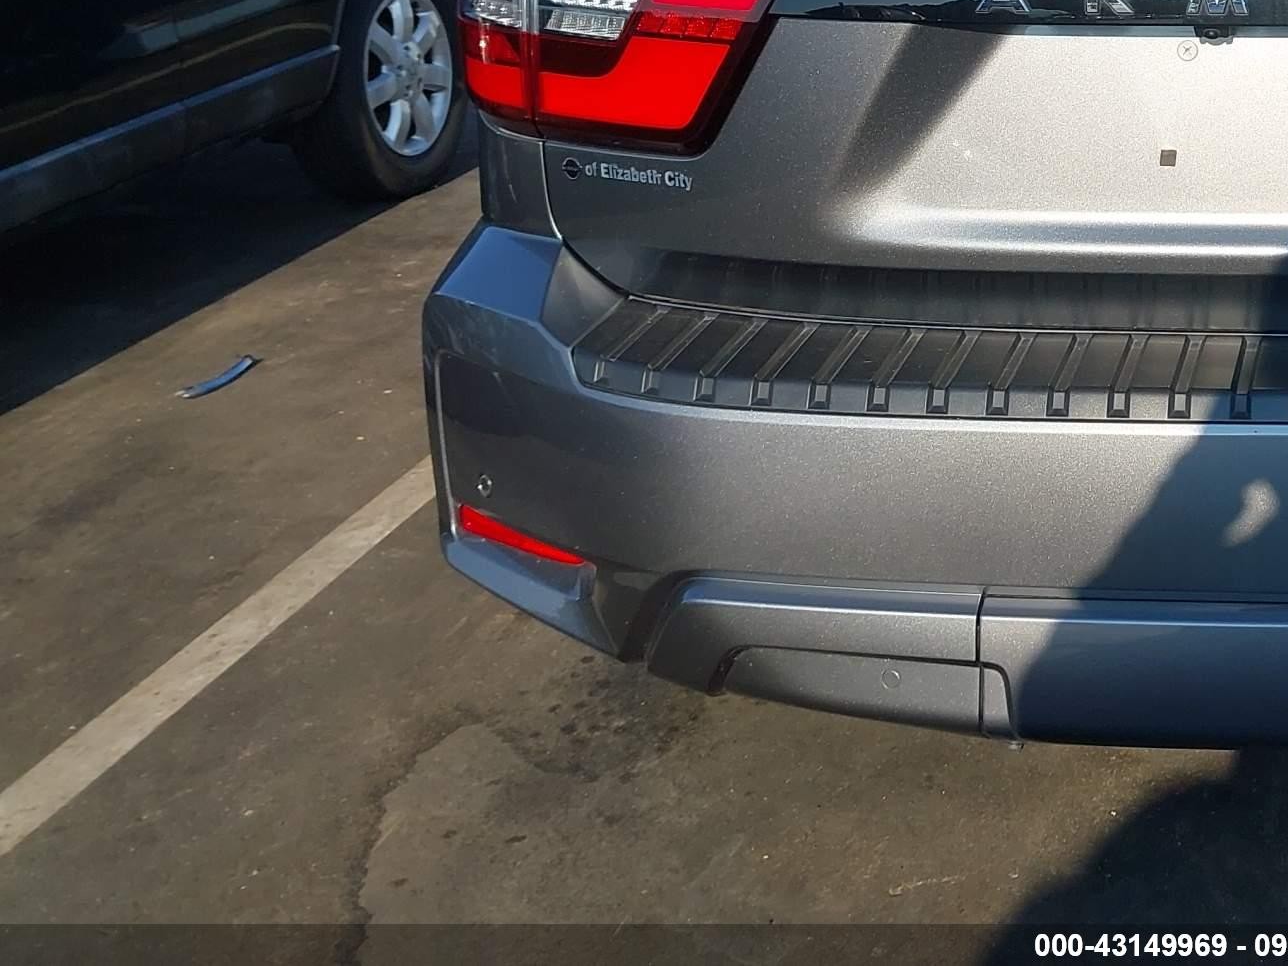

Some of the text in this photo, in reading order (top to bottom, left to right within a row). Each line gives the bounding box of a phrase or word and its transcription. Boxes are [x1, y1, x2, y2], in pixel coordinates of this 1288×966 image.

[585, 162, 693, 191] of Elizabeth City
